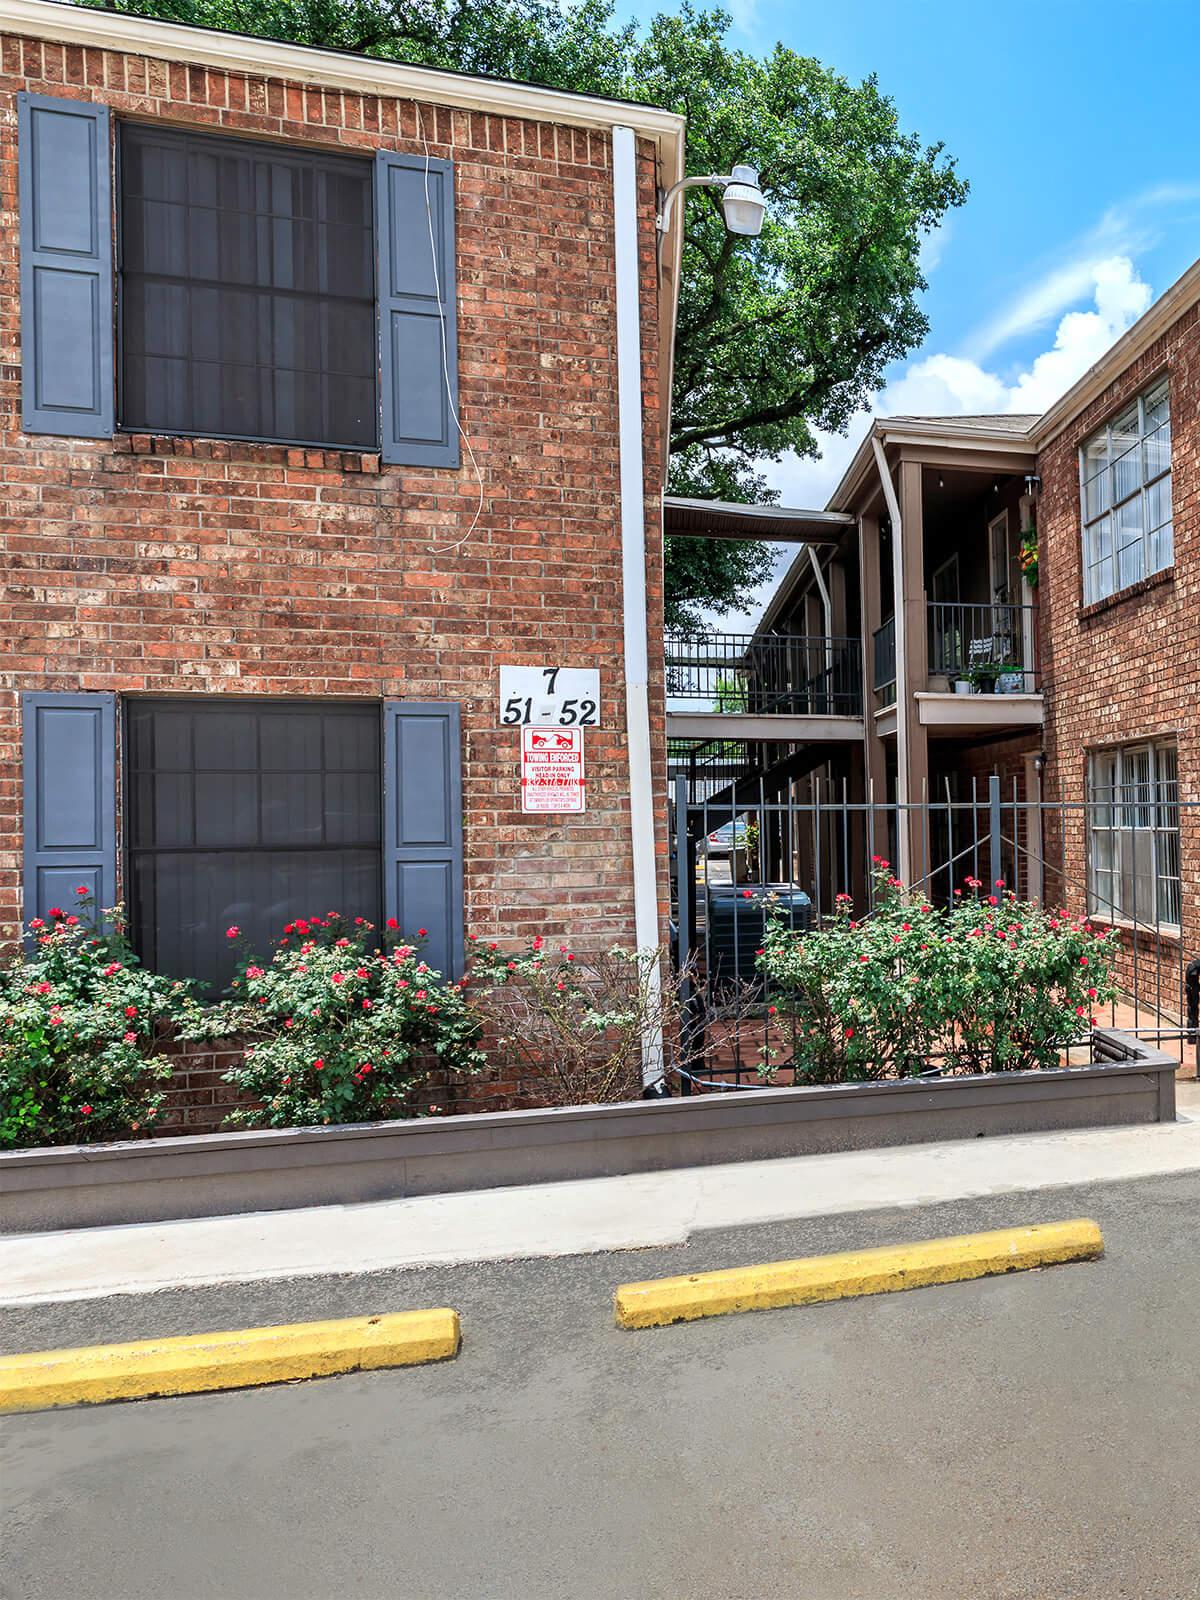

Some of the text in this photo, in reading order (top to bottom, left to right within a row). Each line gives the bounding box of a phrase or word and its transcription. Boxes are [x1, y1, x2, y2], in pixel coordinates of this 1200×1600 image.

[542, 666, 560, 695] 7
[503, 697, 532, 725] 51
[559, 699, 596, 726] 52
[526, 752, 578, 762] TOWING ENFORCED
